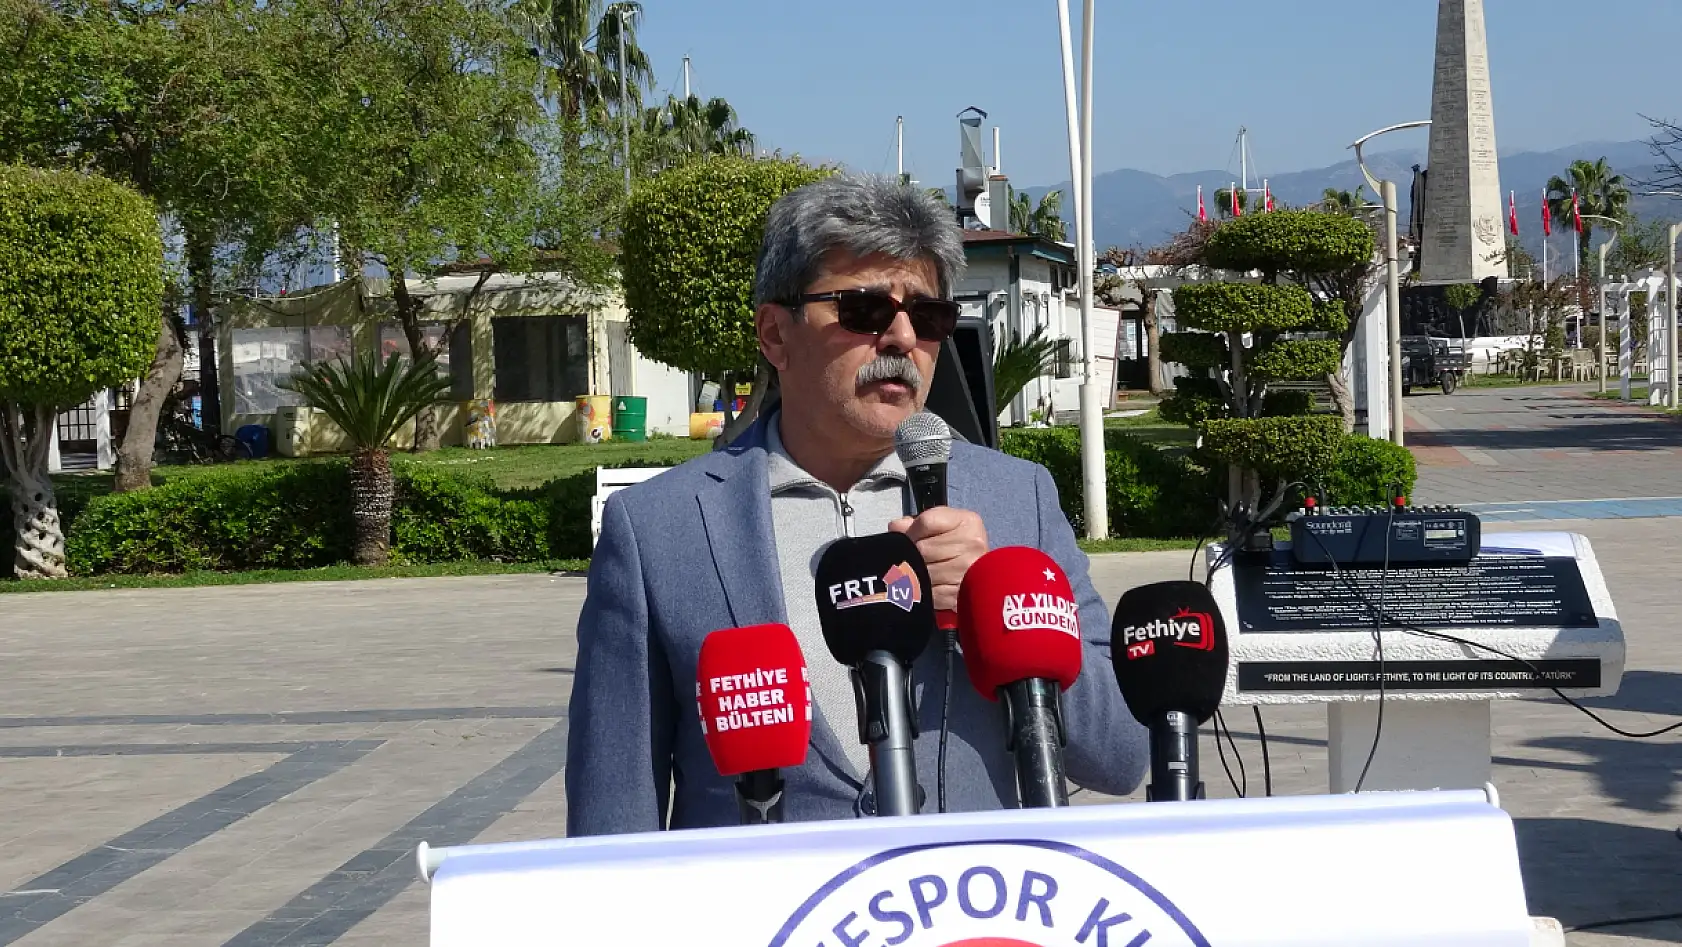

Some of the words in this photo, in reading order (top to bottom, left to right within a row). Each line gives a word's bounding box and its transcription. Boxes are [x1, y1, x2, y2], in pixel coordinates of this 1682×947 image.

[829, 576, 878, 605] FRT
[891, 585, 910, 600] tv
[1003, 593, 1026, 611] AY
[1030, 593, 1080, 615] YILDIZ
[1008, 608, 1080, 635] GÜNDEM
[1123, 618, 1201, 645] Fethiye
[1129, 644, 1150, 657] TV
[709, 667, 788, 693] FETHİYE
[1292, 673, 1309, 682] THE
[1310, 673, 1332, 682] LAND
[1333, 673, 1344, 682] OF
[1345, 673, 1375, 682] LIGHTS
[1412, 672, 1424, 681] TO
[1425, 672, 1441, 681] THE
[1442, 672, 1466, 681] LIGHT
[1467, 671, 1479, 680] OF
[1480, 671, 1493, 680] ITS
[718, 688, 785, 712] HABER
[715, 703, 794, 732] BÜLTENİ
[815, 866, 1059, 947] ESPOR
[1074, 897, 1152, 947] K
